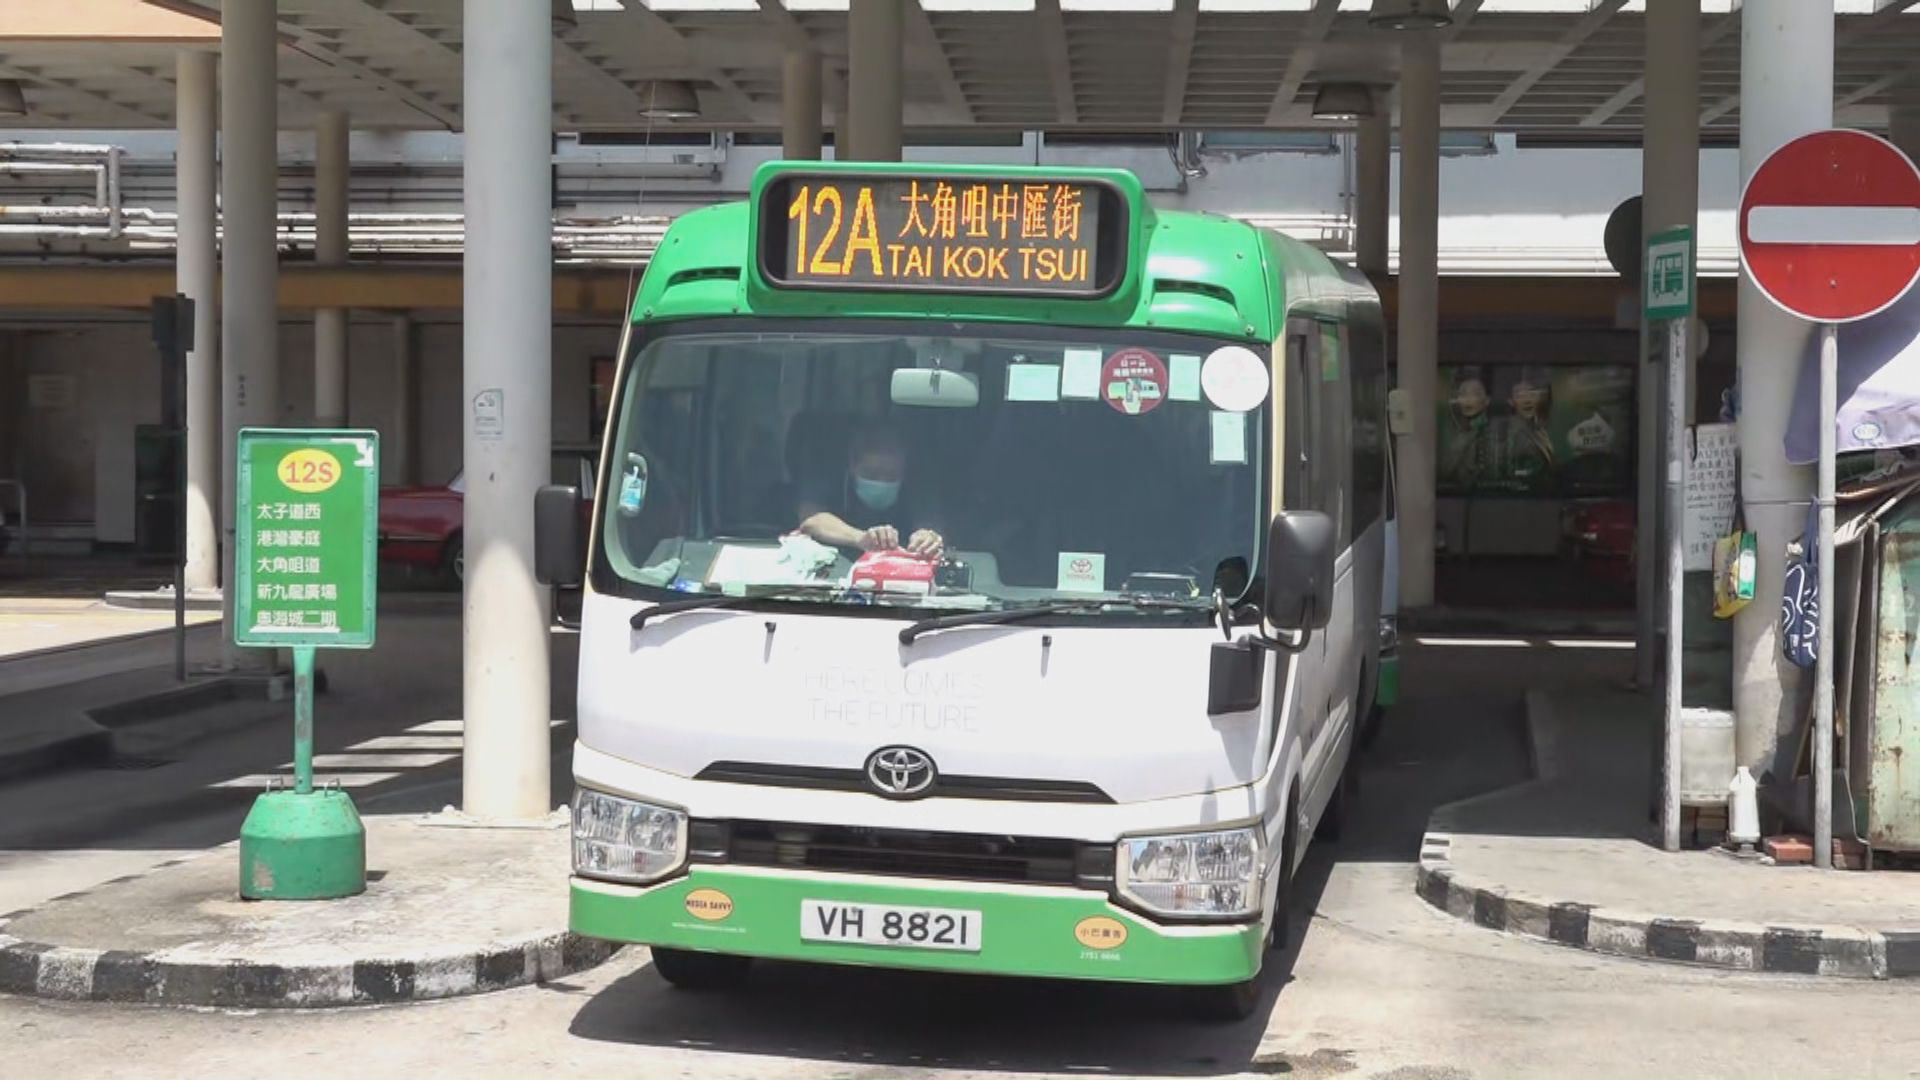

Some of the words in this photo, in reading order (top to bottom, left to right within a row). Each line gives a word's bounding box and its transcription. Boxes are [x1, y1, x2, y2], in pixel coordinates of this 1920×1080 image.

[898, 180, 1082, 241] 大角咀中匯街
[789, 185, 884, 276] 12A
[887, 244, 933, 277] TAI
[943, 246, 1009, 280] KOK
[1018, 248, 1088, 281] TSUI
[285, 461, 334, 484] 12S
[256, 503, 321, 520] 太子道西
[256, 529, 321, 547] 港灣豪庭
[256, 556, 321, 574] 大角咀道
[256, 583, 338, 601] 新九龍廣場
[805, 665, 880, 694] HERE
[884, 669, 985, 699] COMES
[807, 697, 862, 726] THE
[868, 700, 980, 733] FUTURE
[817, 906, 863, 937] VH
[882, 911, 968, 945] 8821
